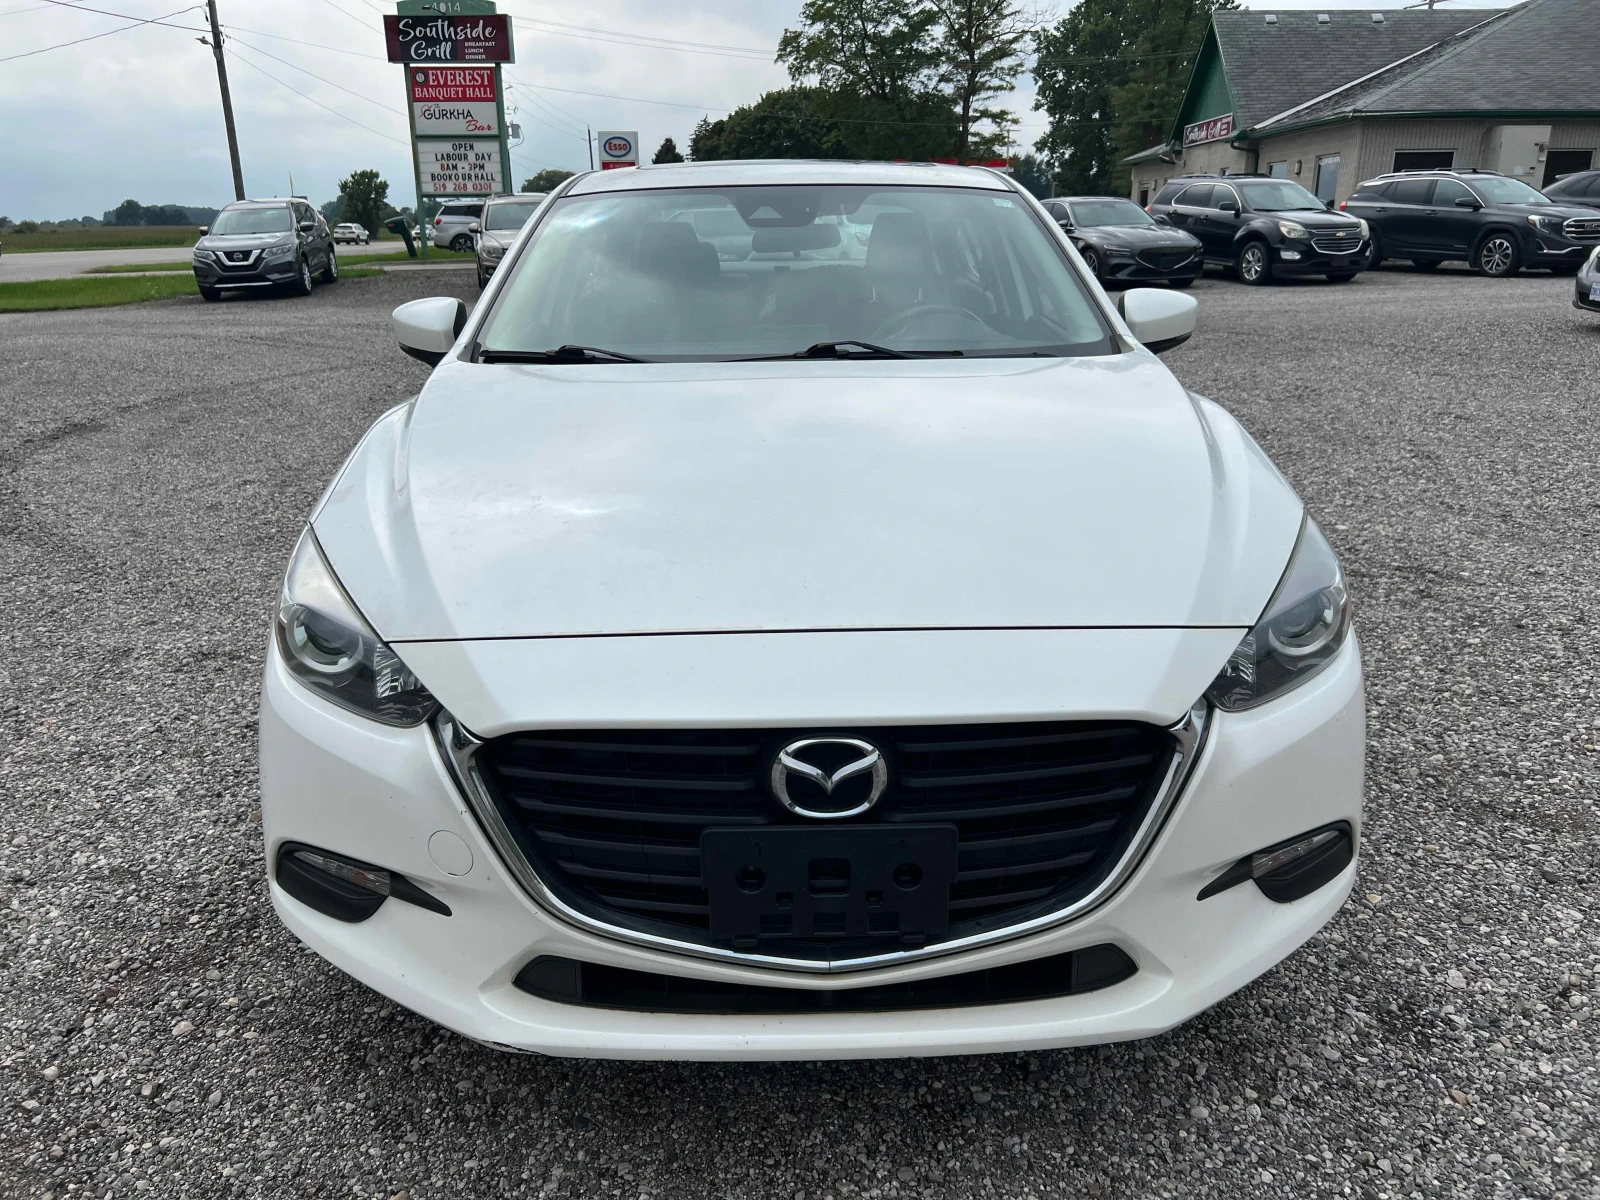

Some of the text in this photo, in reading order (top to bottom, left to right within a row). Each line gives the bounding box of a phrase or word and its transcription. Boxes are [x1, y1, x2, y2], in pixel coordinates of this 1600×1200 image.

[398, 18, 496, 42] Southside
[411, 40, 452, 60] Grill
[428, 70, 491, 86] EVEREST
[415, 87, 493, 100] BANQUET HALL
[423, 108, 474, 120] GURKHA
[465, 119, 494, 132] Bar
[451, 142, 474, 152] OPEN
[434, 153, 492, 162] LABOUR DAY
[440, 163, 458, 172] 8AM
[467, 163, 485, 172] 3PM
[433, 182, 492, 192] 519 268 0301
